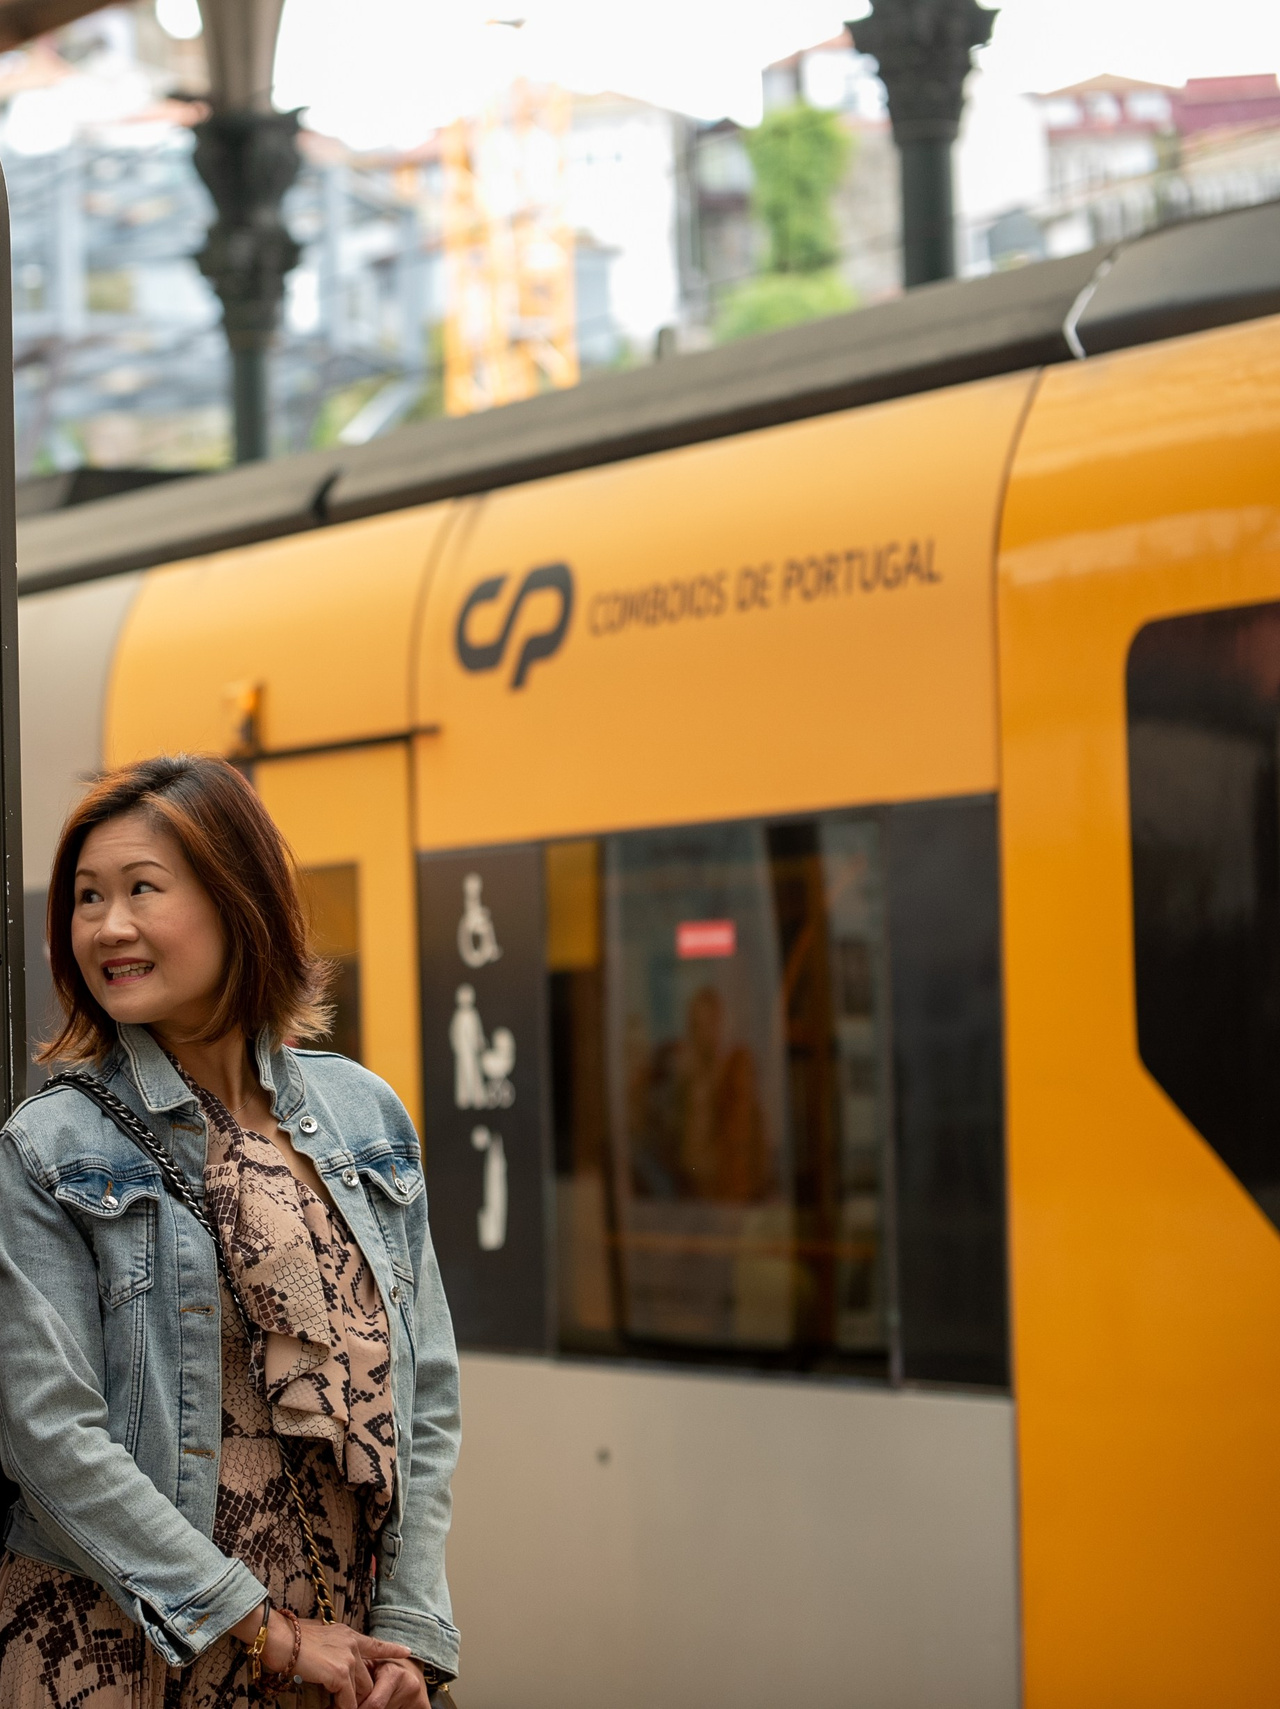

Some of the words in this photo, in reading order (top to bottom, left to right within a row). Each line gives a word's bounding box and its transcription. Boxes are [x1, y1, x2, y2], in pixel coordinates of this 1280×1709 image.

[588, 569, 728, 637] COMBOIOS
[737, 562, 773, 612] DE
[782, 537, 943, 606] PORTUGAL
